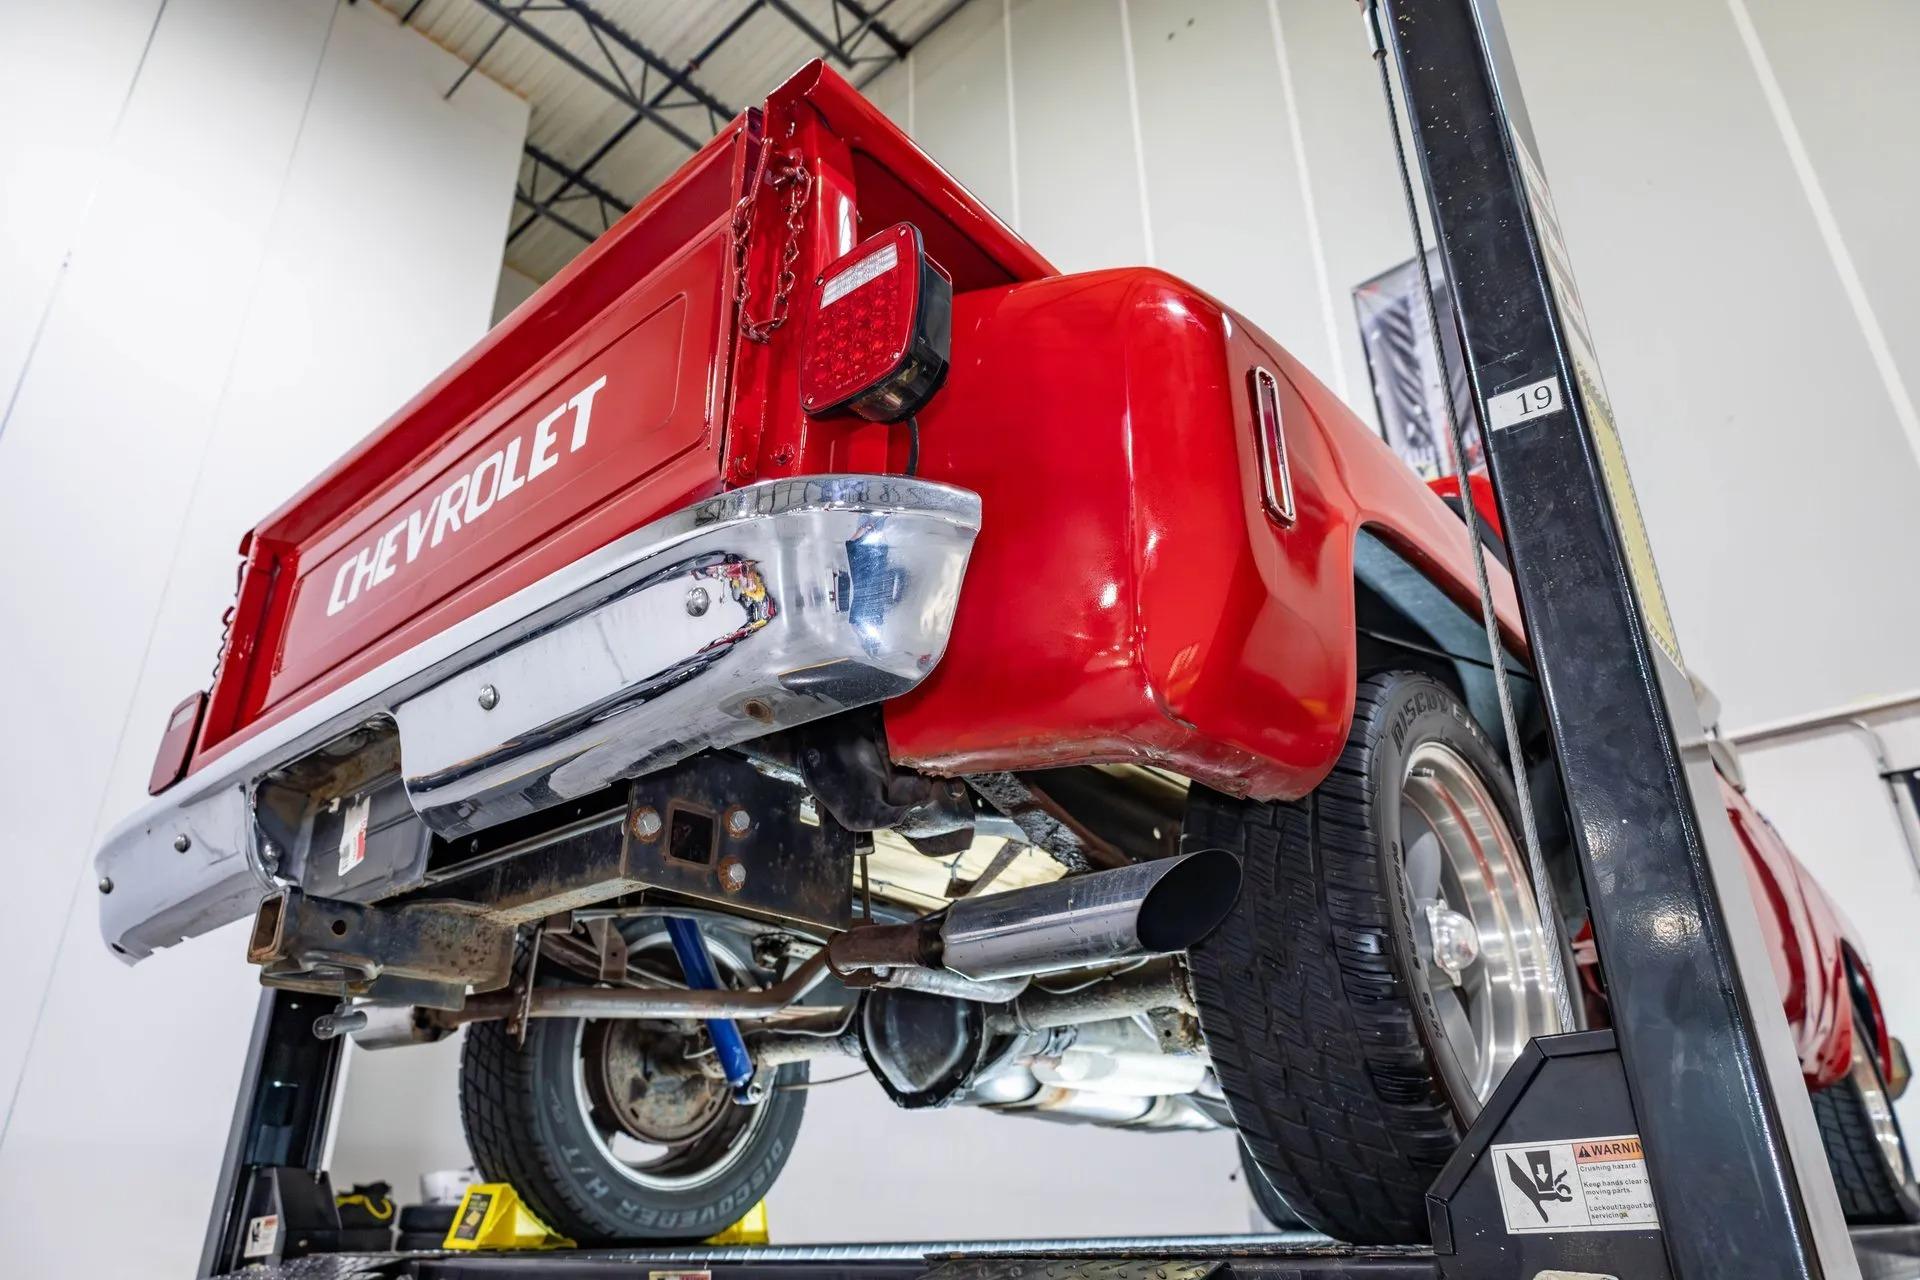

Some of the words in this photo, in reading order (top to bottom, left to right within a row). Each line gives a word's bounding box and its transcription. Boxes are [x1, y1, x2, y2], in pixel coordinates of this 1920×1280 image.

[1516, 385, 1552, 416] 19
[327, 375, 607, 616] CHEVROLET
[1591, 1142, 1643, 1156] WARNIN
[1580, 1164, 1611, 1172] Crushing
[615, 1137, 784, 1229] DISCOVERER
[1602, 1179, 1624, 1187] hands
